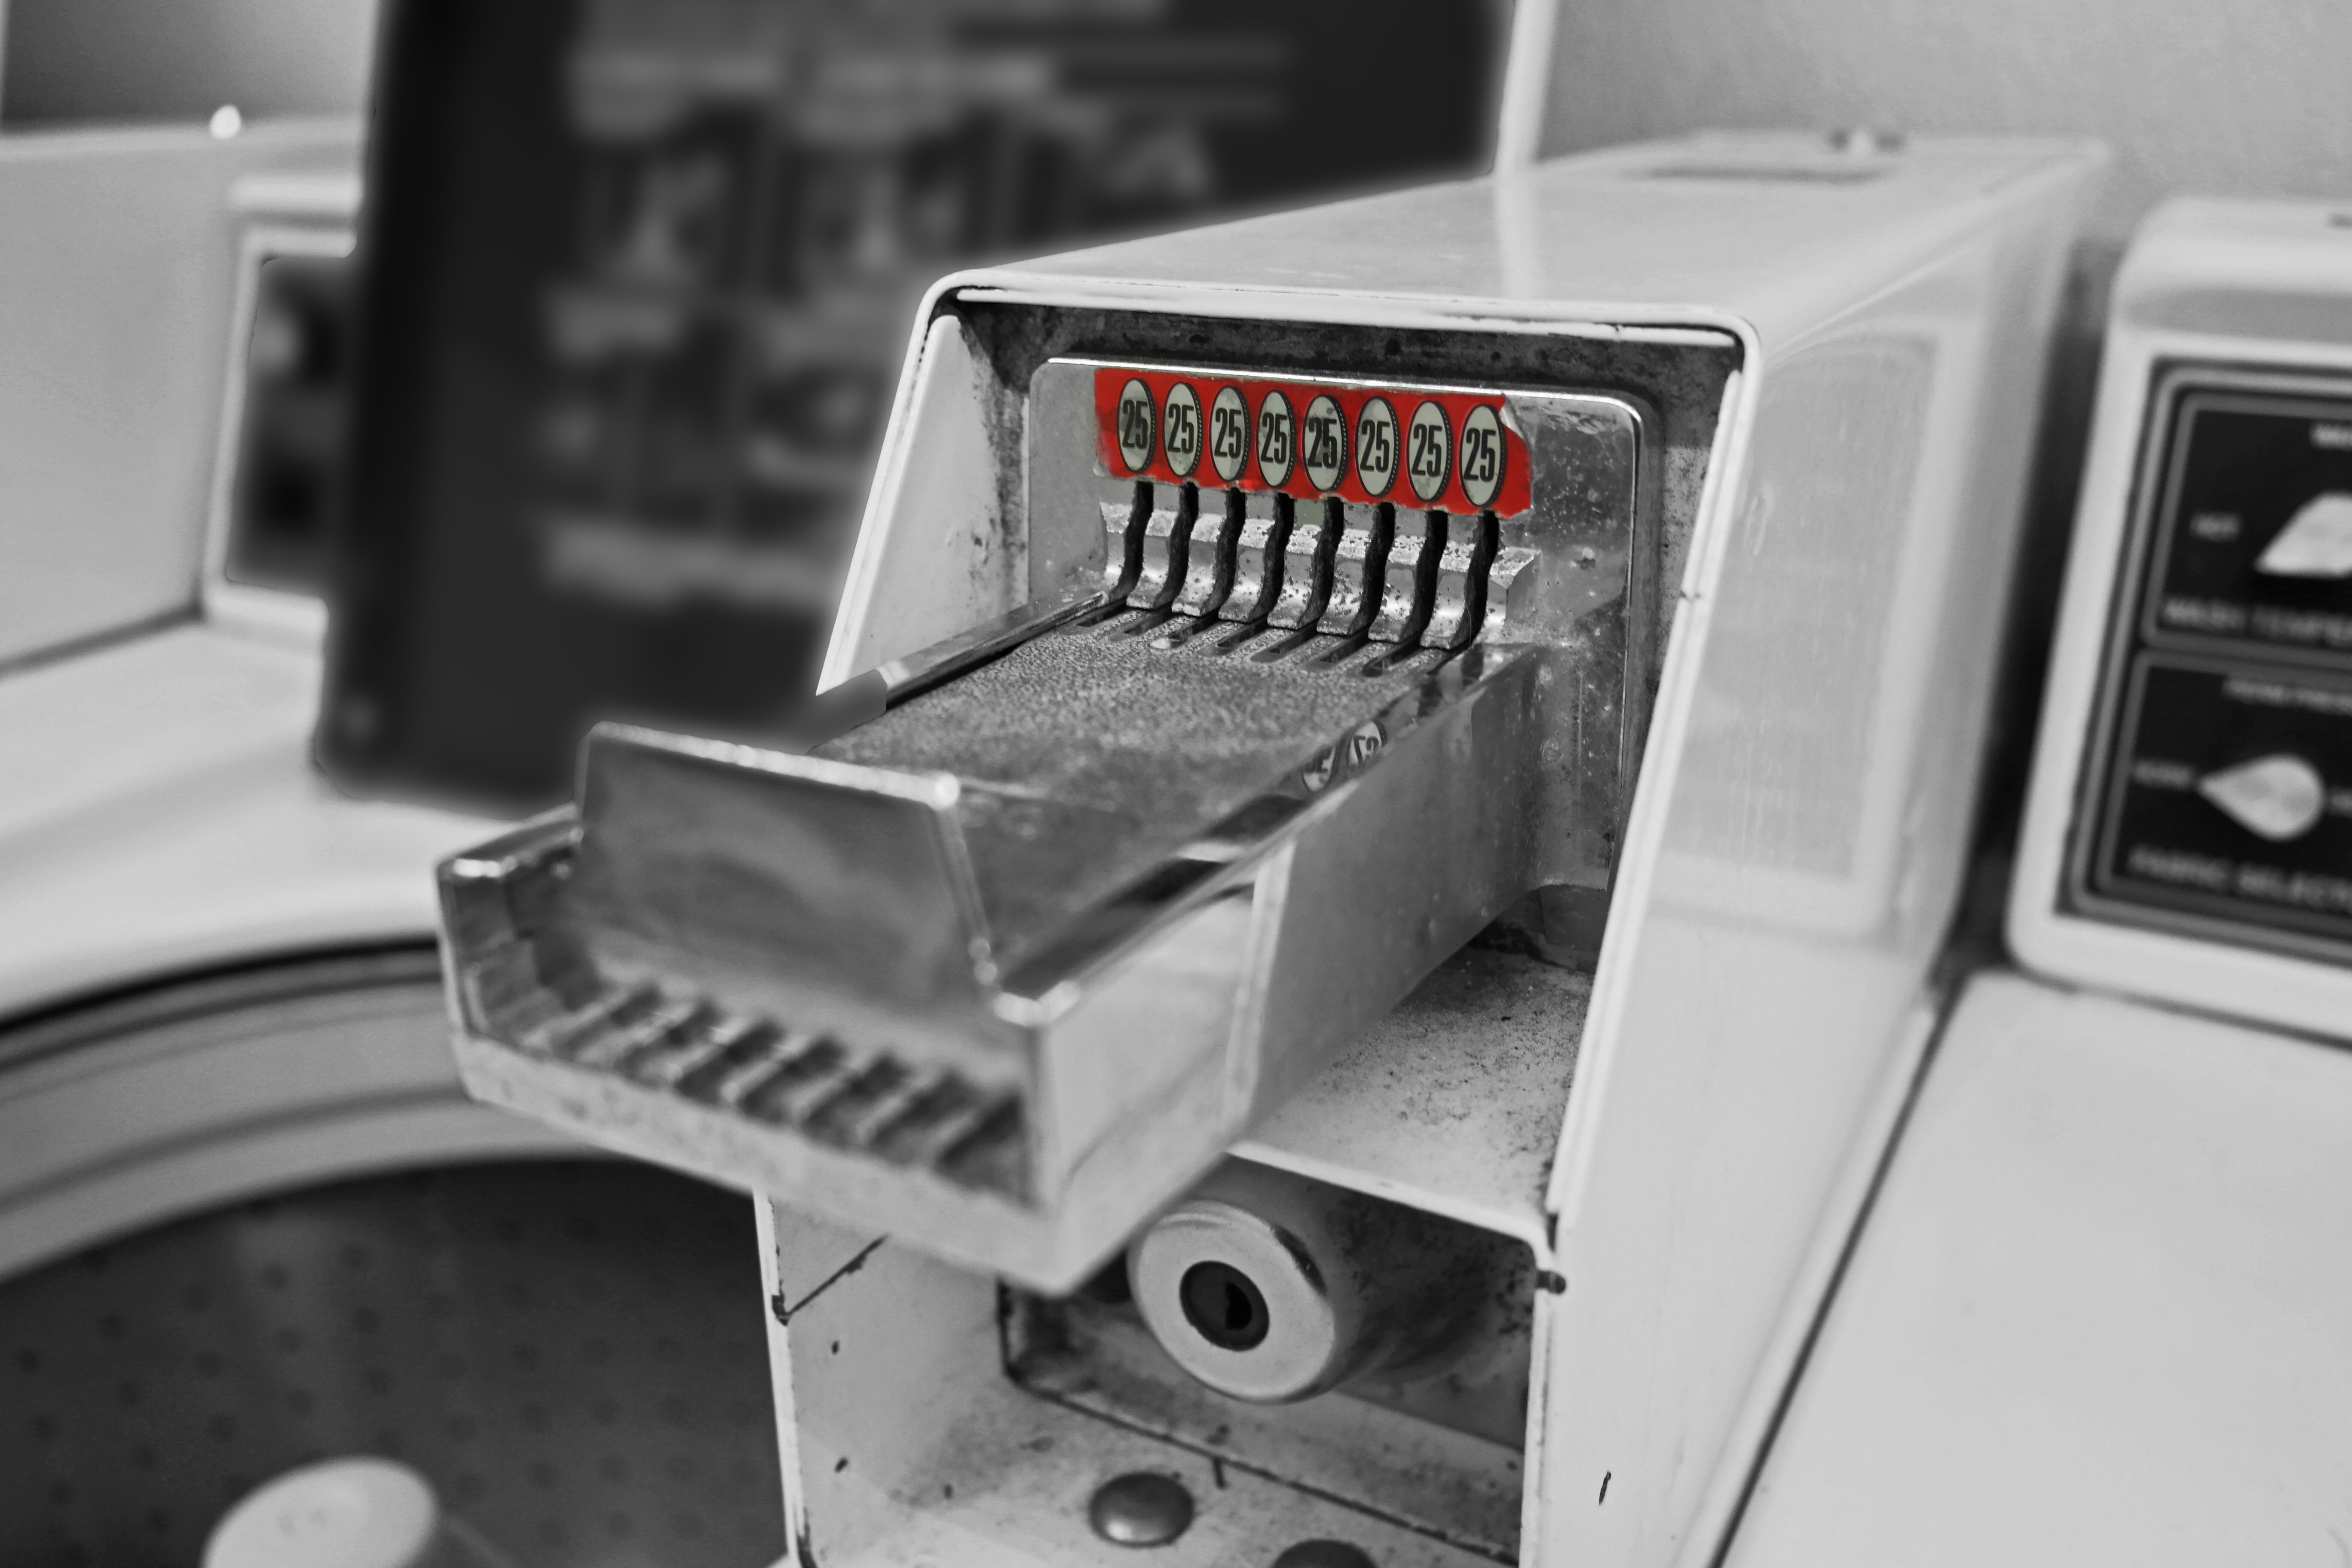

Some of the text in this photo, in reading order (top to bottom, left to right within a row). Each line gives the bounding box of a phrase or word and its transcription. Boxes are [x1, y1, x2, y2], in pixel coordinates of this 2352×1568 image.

[1123, 400, 1496, 481] 25 25 25 25 25 25 25 25
